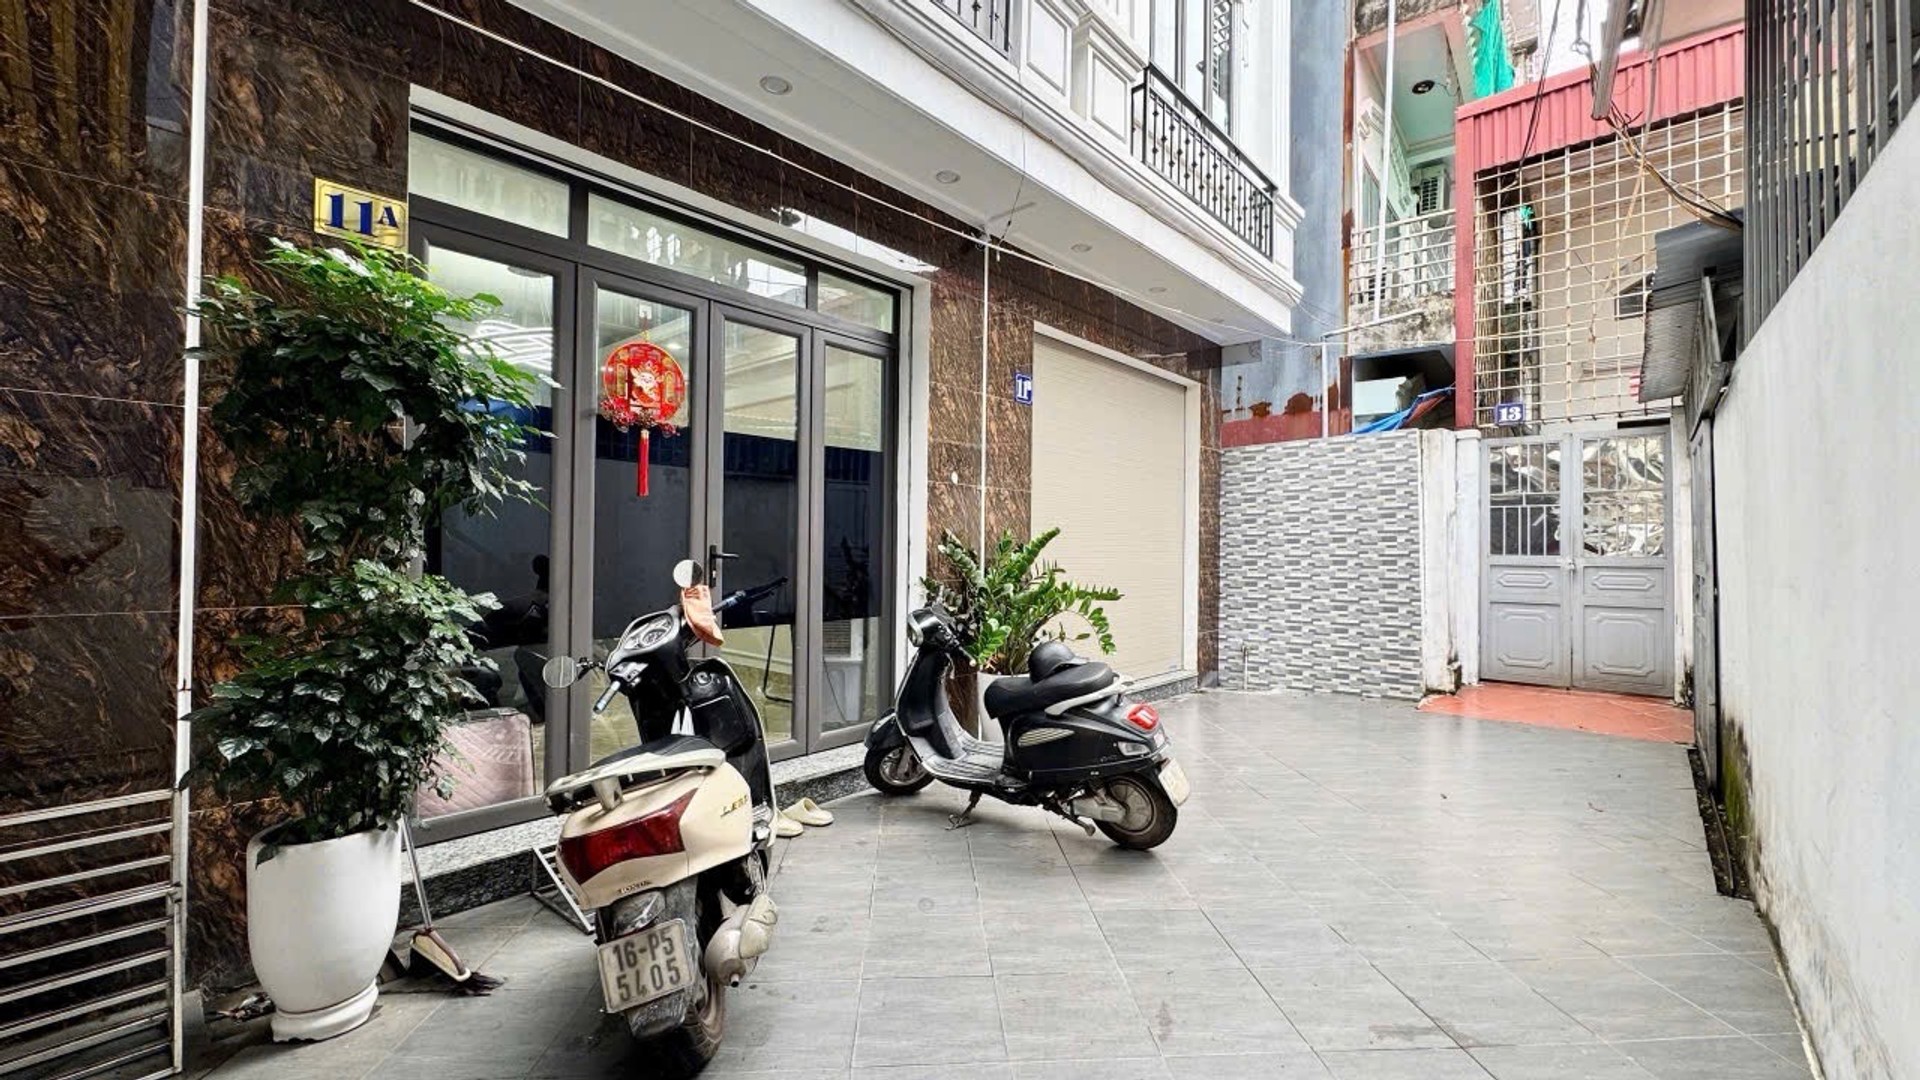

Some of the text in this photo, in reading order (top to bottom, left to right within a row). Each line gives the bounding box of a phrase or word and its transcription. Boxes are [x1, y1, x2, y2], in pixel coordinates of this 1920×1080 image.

[325, 193, 399, 238] 11A
[1499, 406, 1521, 422] 13
[613, 926, 674, 971] 16-P5
[616, 957, 680, 1001] 5405
